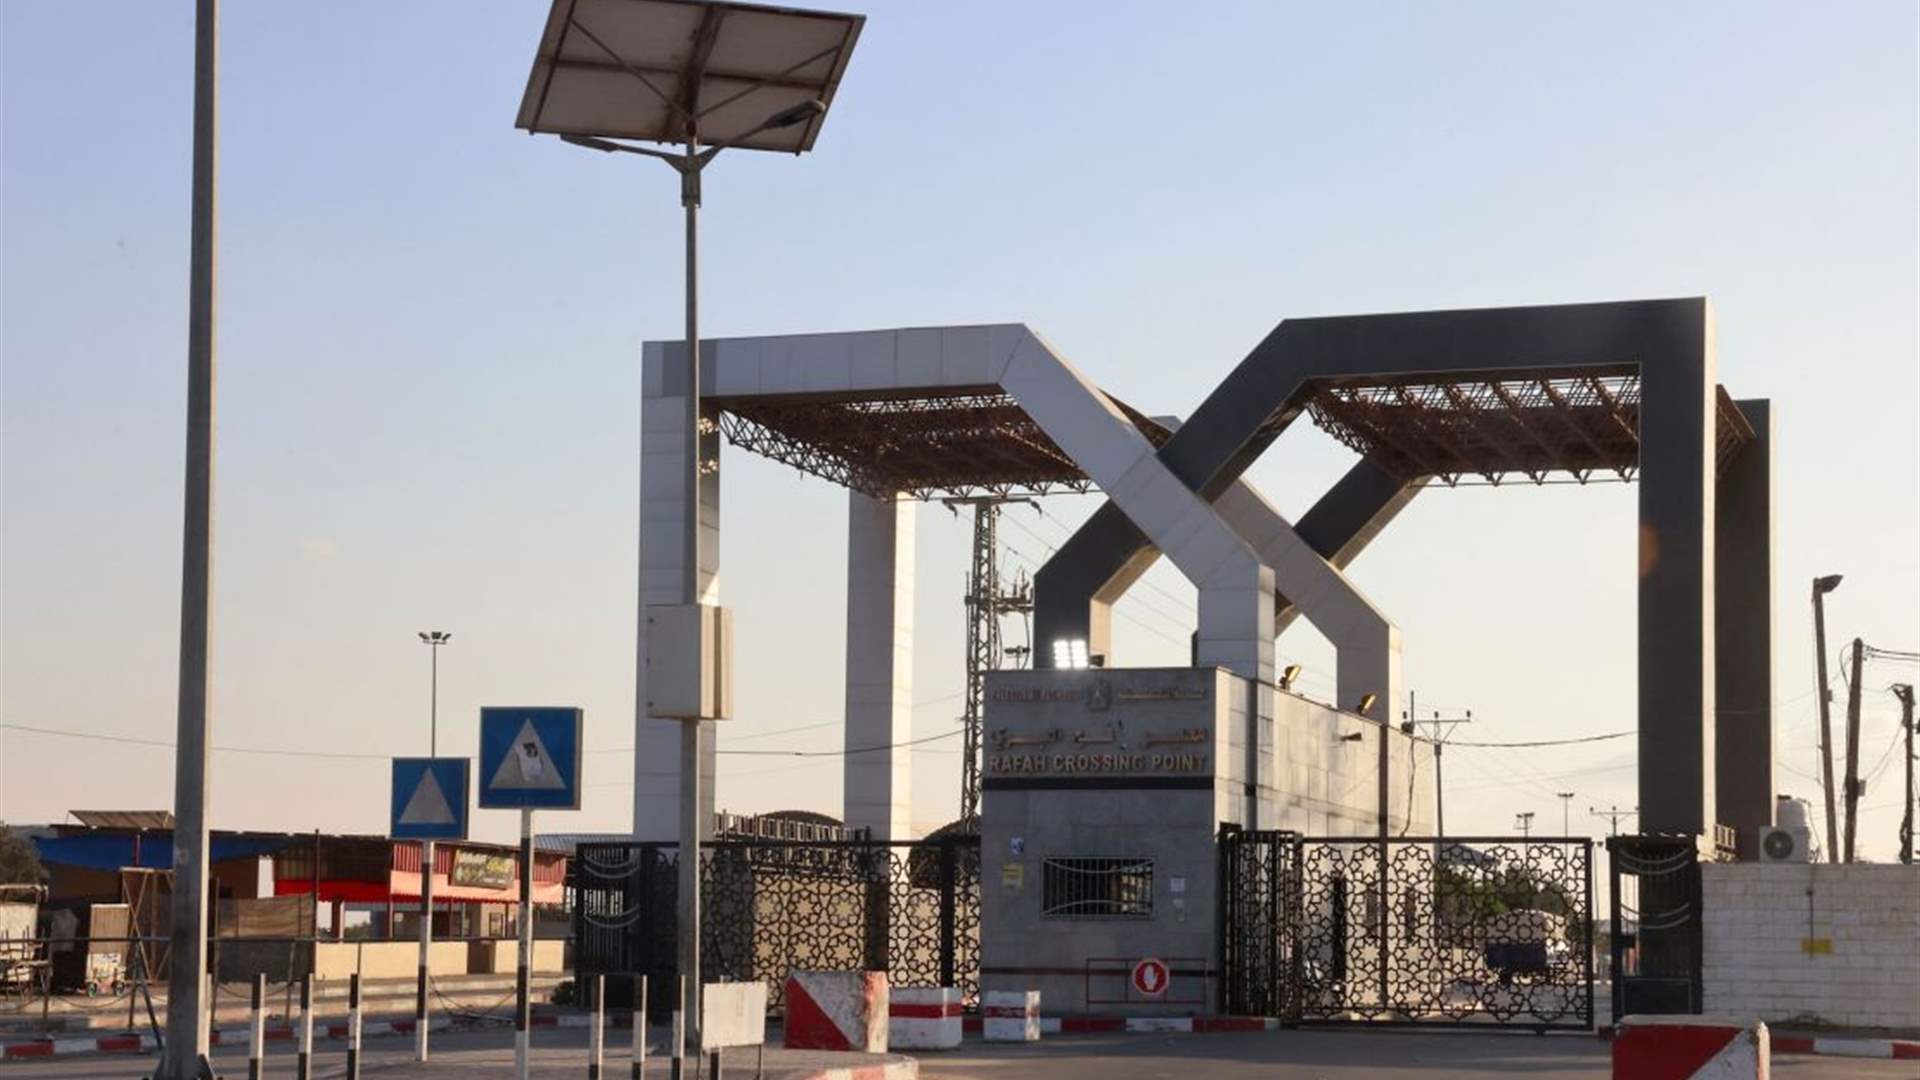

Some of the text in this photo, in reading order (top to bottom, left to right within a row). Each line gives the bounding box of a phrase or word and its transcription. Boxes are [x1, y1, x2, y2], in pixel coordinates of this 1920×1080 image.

[989, 753, 1207, 772] RAFAH CROSSING POINT
